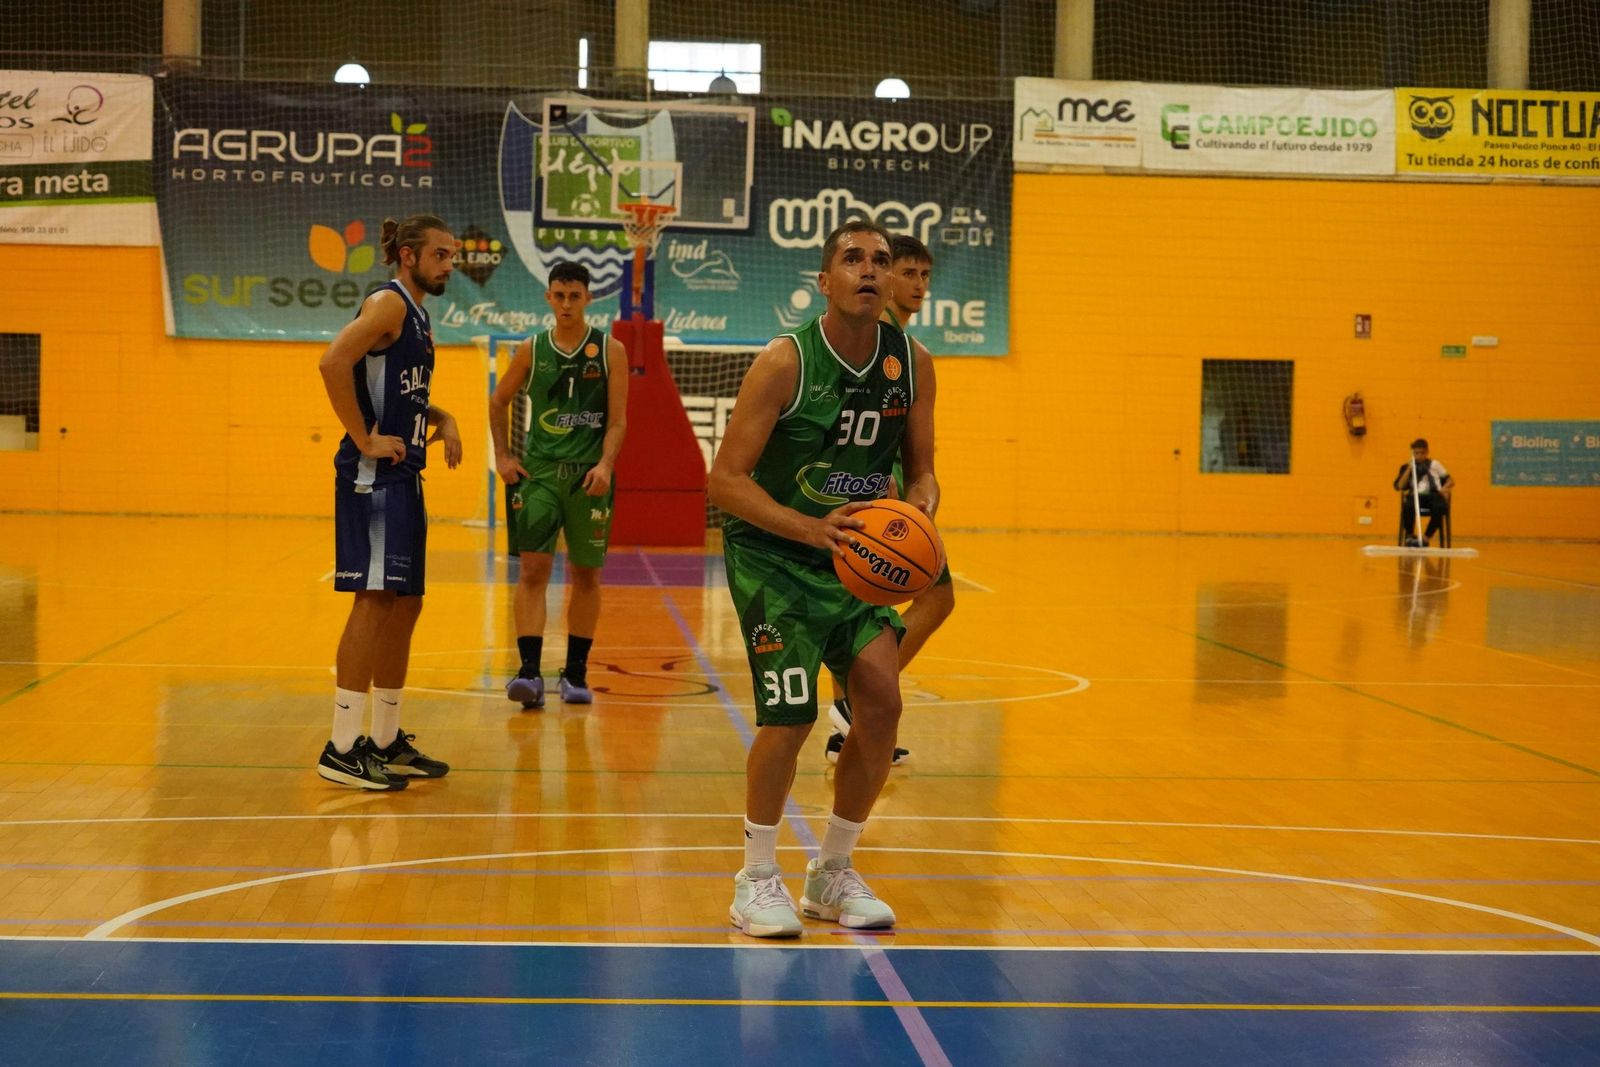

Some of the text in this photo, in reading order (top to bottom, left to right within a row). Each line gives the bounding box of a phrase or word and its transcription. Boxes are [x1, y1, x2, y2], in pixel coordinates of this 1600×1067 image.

[1196, 114, 1378, 138] CAMPOEJIDO
[173, 128, 432, 167] AGRUPA2
[570, 136, 636, 149] DPORTIVO
[1196, 138, 1373, 153] Cultivando el futuro desde 1979
[828, 157, 930, 172] BIOTECH
[1407, 153, 1424, 166] Tu
[1427, 153, 1474, 168] tienda
[1477, 155, 1495, 168] 24
[1500, 155, 1540, 169] horas
[1543, 156, 1561, 169] de
[34, 169, 109, 194] meta
[172, 167, 433, 188] HORTOFRUTÍCOLA
[538, 228, 629, 241] FUTSA
[668, 239, 709, 263] imd
[440, 302, 466, 328] La
[944, 331, 985, 344] Iberia
[568, 376, 575, 398] 1
[837, 409, 881, 446] 30
[1512, 435, 1560, 449] Bioline
[821, 471, 891, 495] FitoSu
[763, 666, 810, 706] 30
